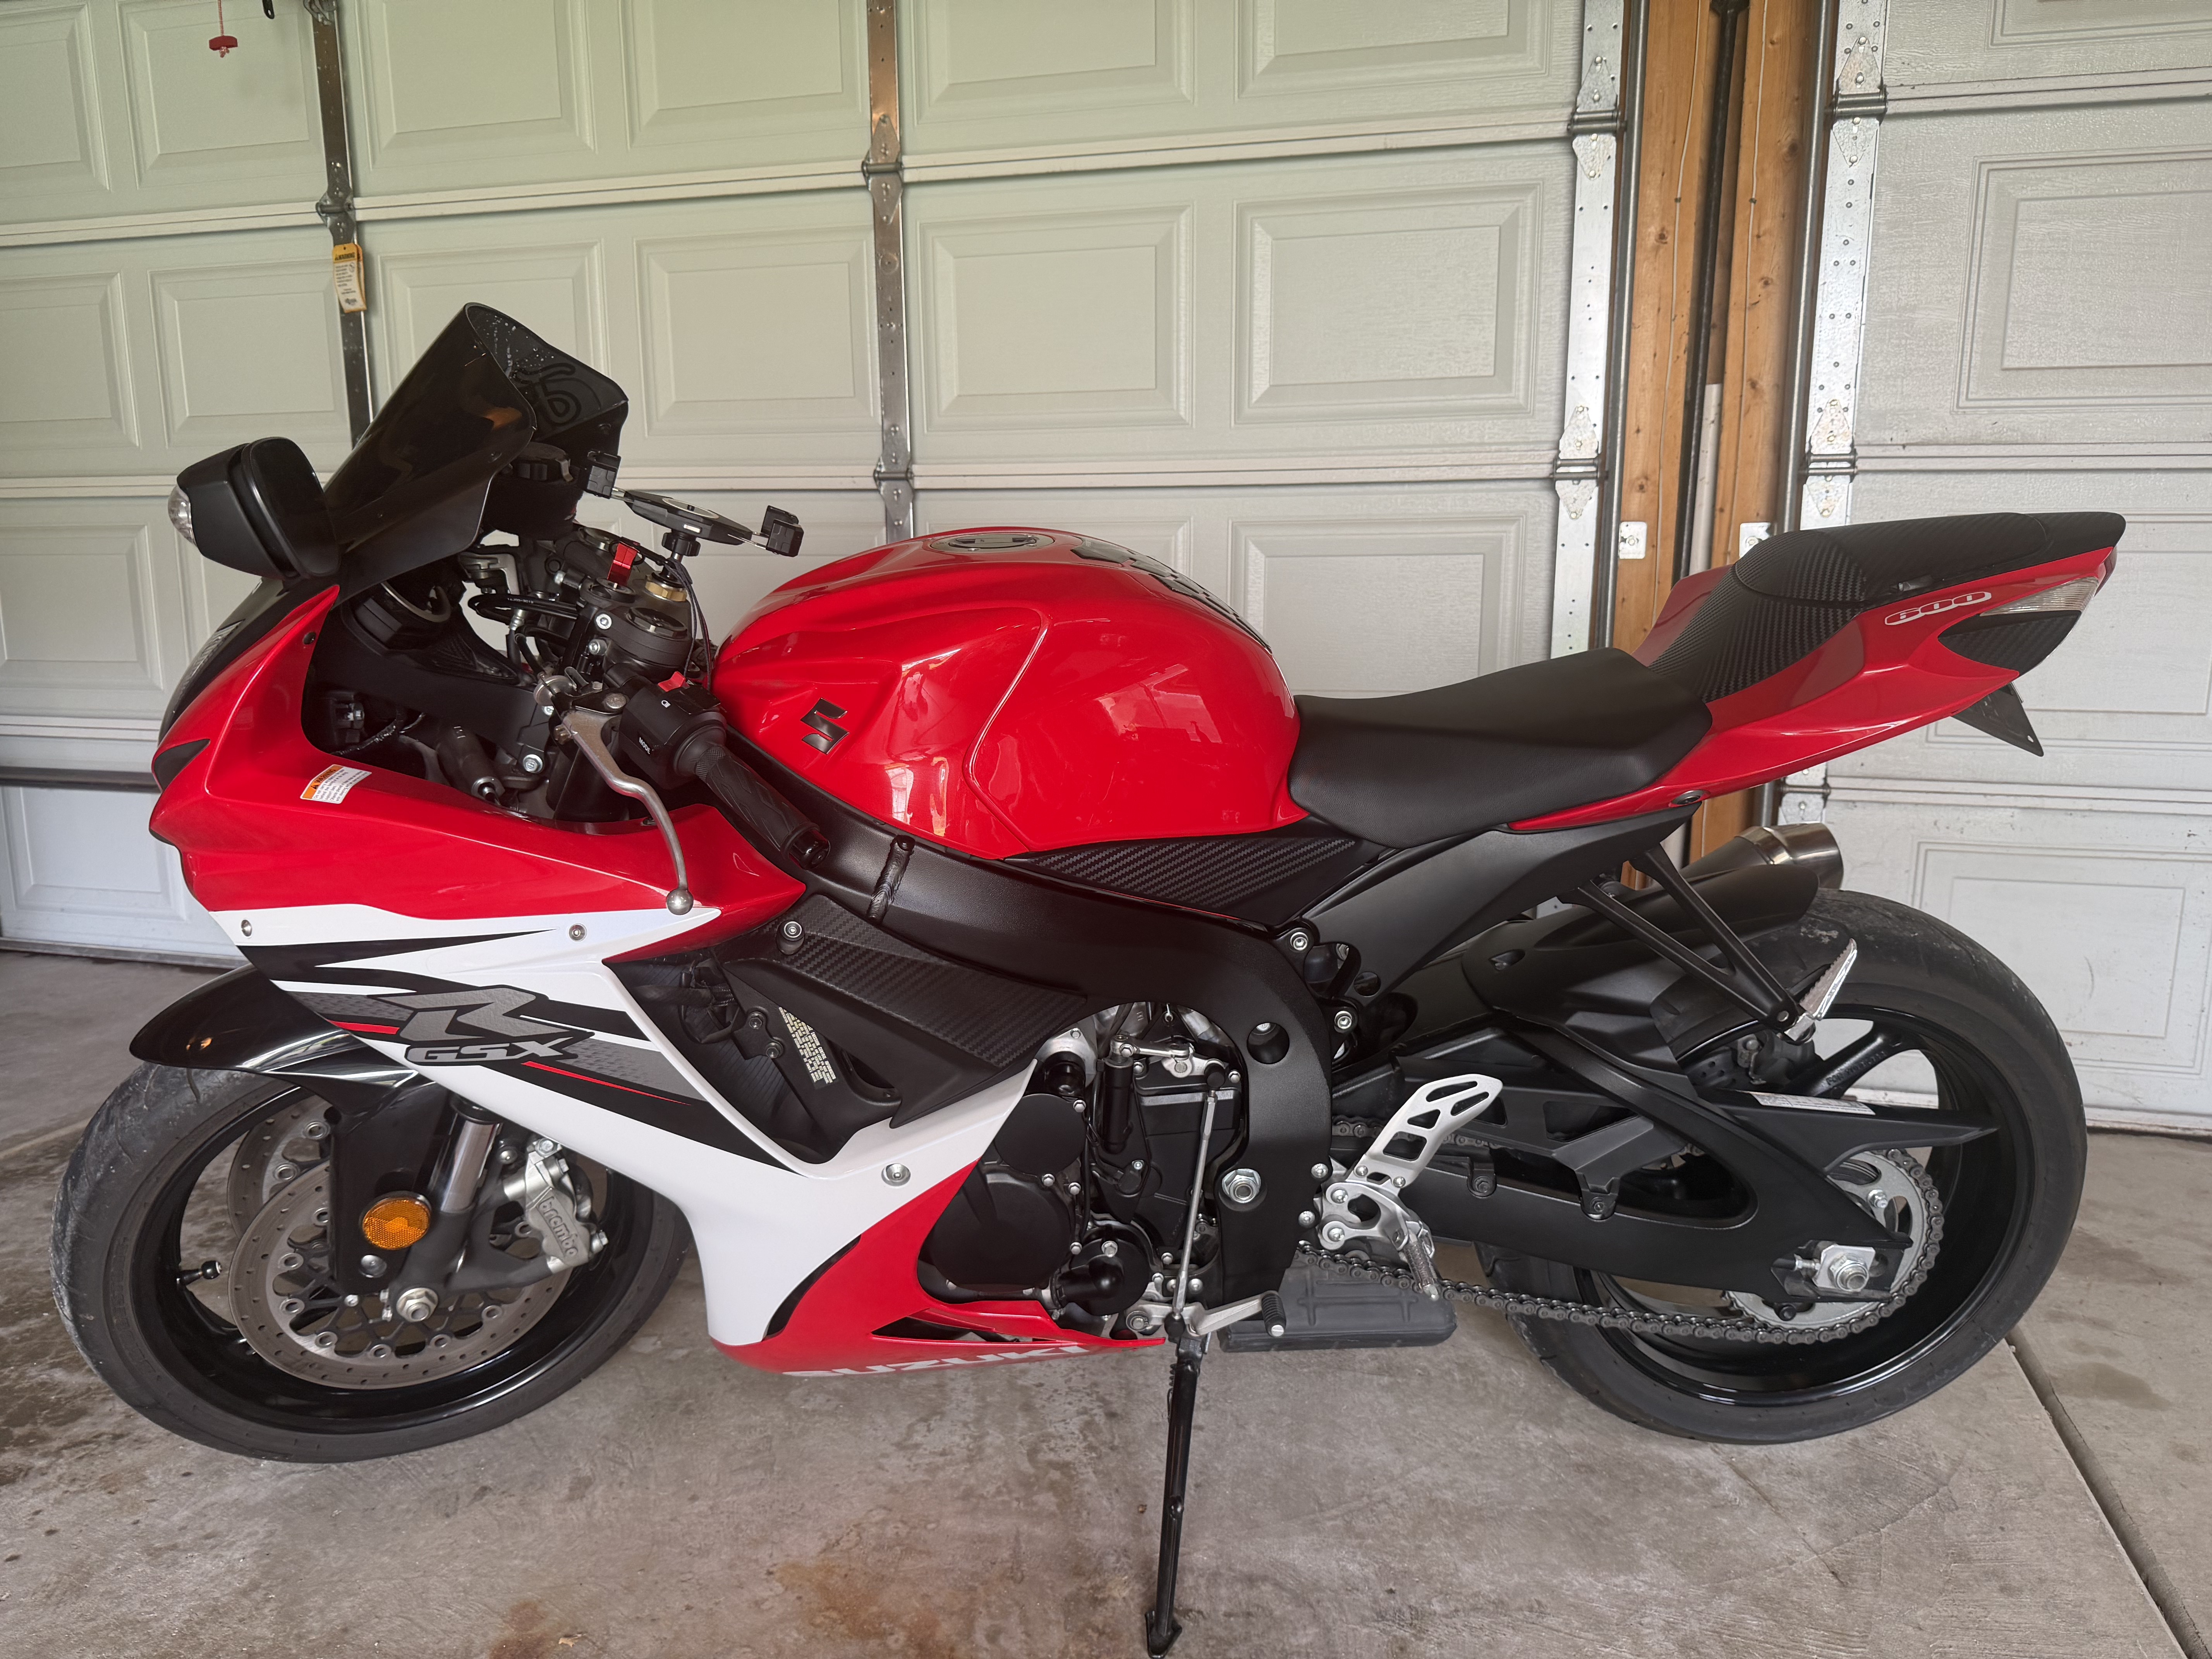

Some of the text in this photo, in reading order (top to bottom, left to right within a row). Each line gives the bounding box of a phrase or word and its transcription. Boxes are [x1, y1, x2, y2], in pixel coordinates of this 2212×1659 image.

[1885, 591, 1992, 625] 600
[639, 737, 651, 754] MODE
[376, 988, 571, 1041] R
[407, 1037, 574, 1062] GSX
[539, 1196, 579, 1256] brembo
[782, 1345, 1089, 1377] SUZUKI
